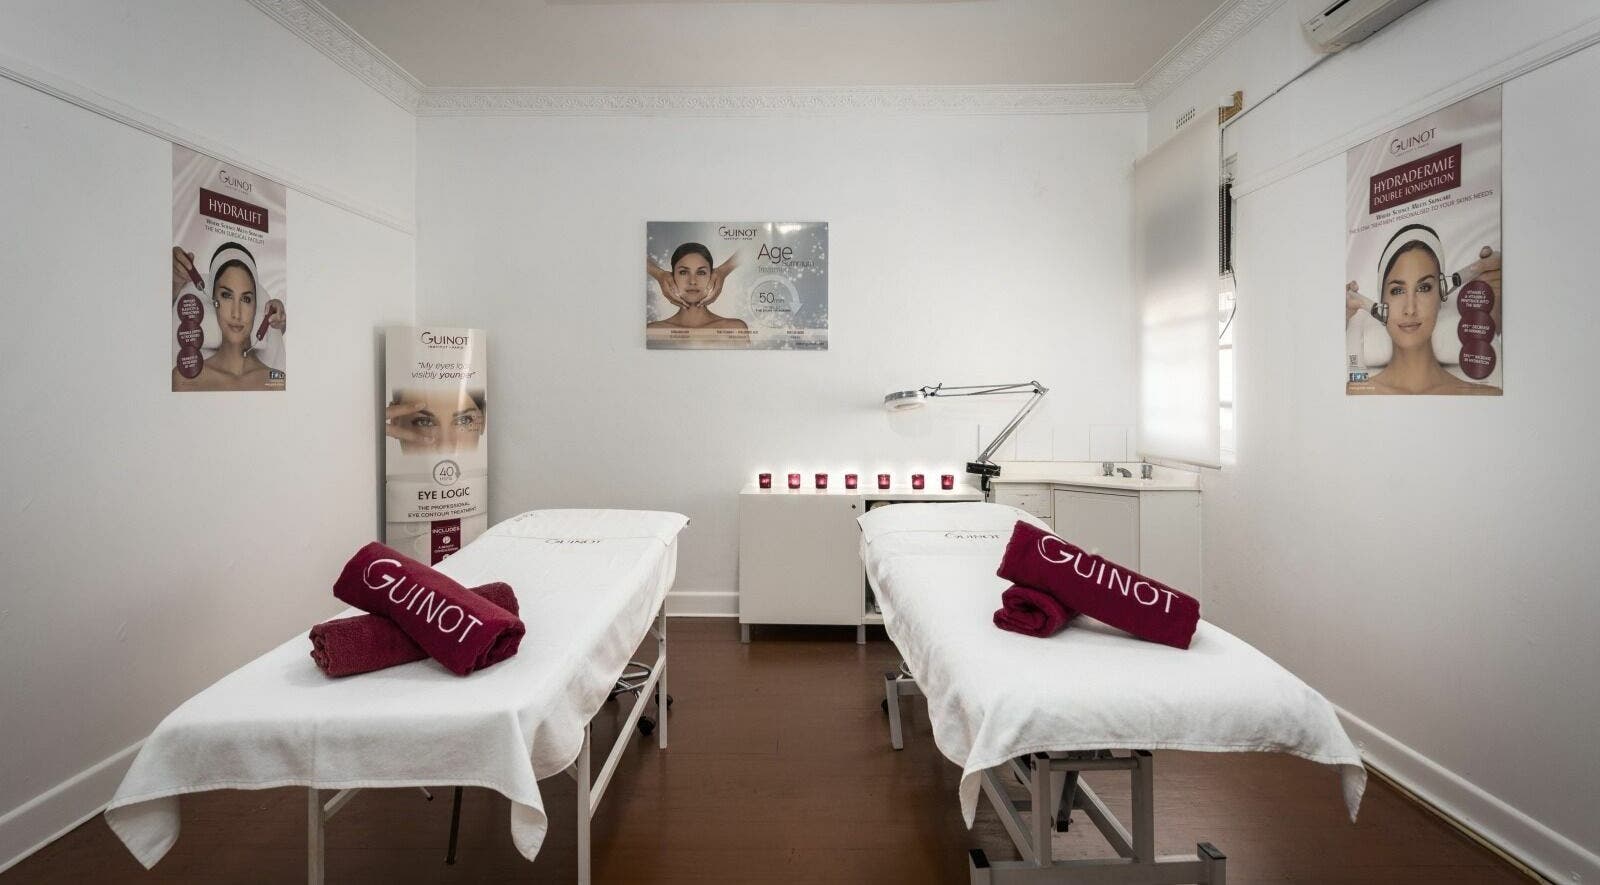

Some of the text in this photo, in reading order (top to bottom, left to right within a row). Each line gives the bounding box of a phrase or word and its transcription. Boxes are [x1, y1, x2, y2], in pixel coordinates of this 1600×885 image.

[1390, 128, 1436, 155] GUINOT
[218, 170, 253, 193] GUINOT
[1373, 155, 1456, 194] HYDRADERMIE
[1373, 172, 1455, 206] DOUBLE IONISATION
[1439, 200, 1455, 210] YOUR
[1473, 189, 1494, 200] NEEDS
[209, 198, 262, 225] HYDRALIFT
[718, 226, 757, 237] GUINOT
[757, 243, 793, 264] Age
[421, 331, 469, 345] GUINOT
[411, 370, 437, 379] visibly
[439, 466, 454, 477] 40
[418, 486, 471, 500] EYE LOGIC
[421, 509, 450, 518] CONTOUR
[450, 506, 477, 516] TREATMENT
[430, 502, 471, 511] PROFESSIONAL
[432, 526, 460, 535] INCLUDES
[1037, 534, 1180, 614] GUINOT
[363, 558, 484, 643] GUINOT
